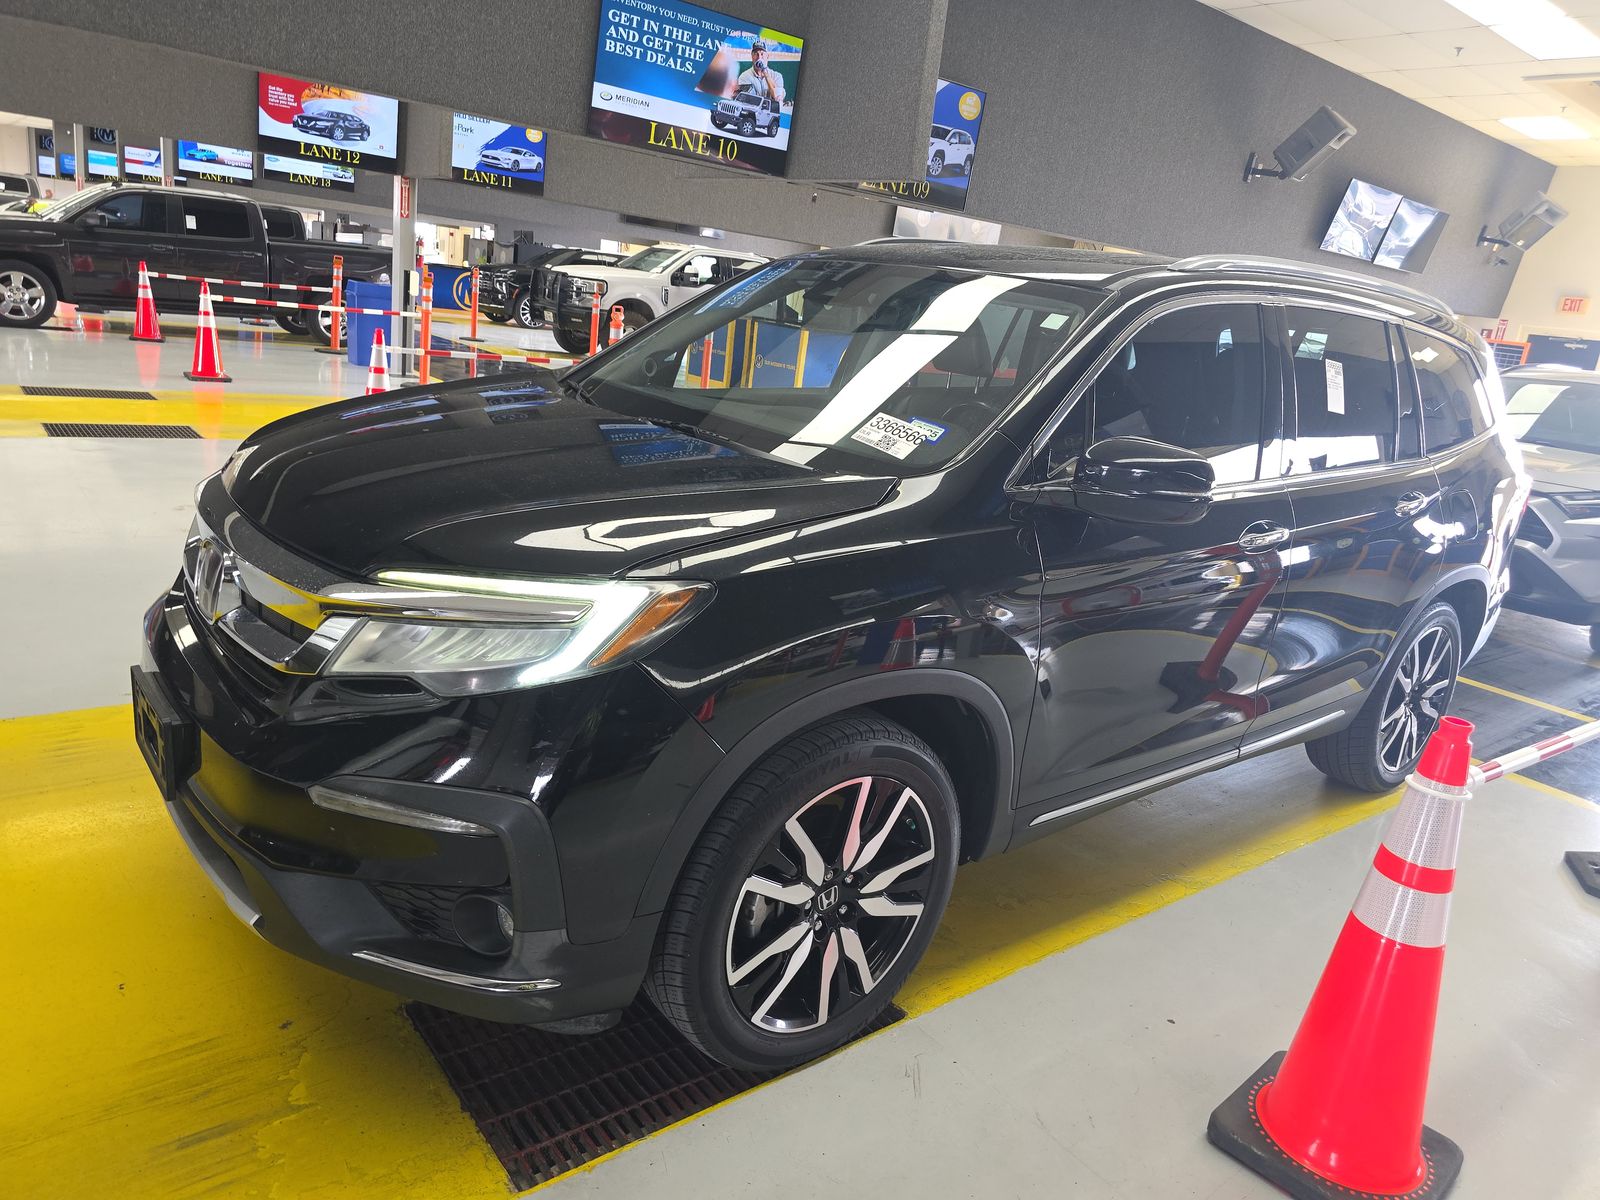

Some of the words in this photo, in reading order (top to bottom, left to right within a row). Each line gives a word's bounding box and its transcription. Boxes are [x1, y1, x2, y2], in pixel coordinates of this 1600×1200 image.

[612, 0, 658, 13] NVENTORY
[659, 8, 676, 19] YOU
[677, 13, 700, 27] NEED,
[701, 20, 725, 33] TRUST
[608, 8, 641, 29] GET
[643, 18, 660, 34] IN
[662, 24, 692, 44] THE
[695, 33, 732, 52] LANE
[606, 25, 640, 43] AND
[642, 34, 673, 52] GET
[675, 42, 705, 62] THE
[605, 39, 644, 58] BEST
[646, 50, 696, 75] DEALS.
[615, 94, 650, 108] MERIDIAN
[648, 121, 711, 157] LANE
[715, 137, 738, 161] 10
[300, 142, 342, 161] LANE
[347, 151, 361, 164] 12
[224, 160, 252, 169] Together.
[199, 172, 224, 183] LANE
[225, 176, 233, 184] 14
[289, 173, 319, 187] LANE
[321, 179, 331, 188] 13
[463, 169, 498, 186] LANE
[501, 175, 513, 188] 11
[912, 180, 930, 199] 09
[1562, 298, 1583, 313] EXIT
[870, 416, 928, 446] 3366566
